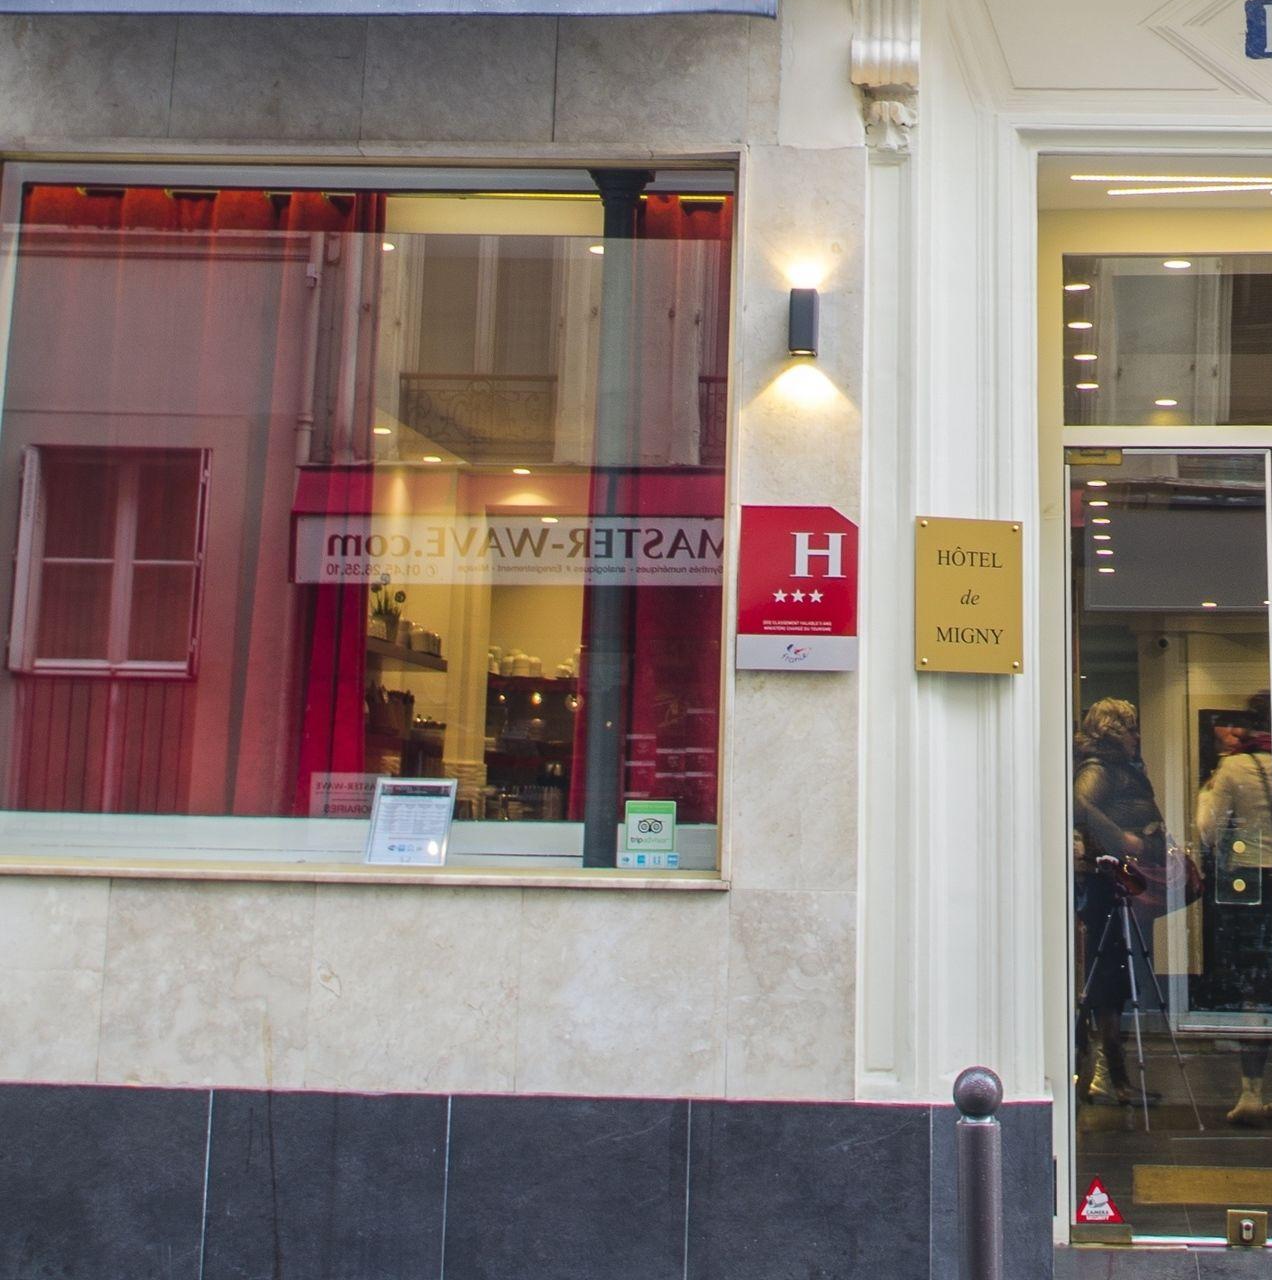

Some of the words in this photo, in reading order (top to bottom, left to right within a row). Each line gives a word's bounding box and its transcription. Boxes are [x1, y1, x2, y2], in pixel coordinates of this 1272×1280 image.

[790, 532, 847, 578] H
[937, 546, 1002, 569] HÔTEL
[960, 589, 980, 606] de
[936, 626, 1004, 645] MIGNY
